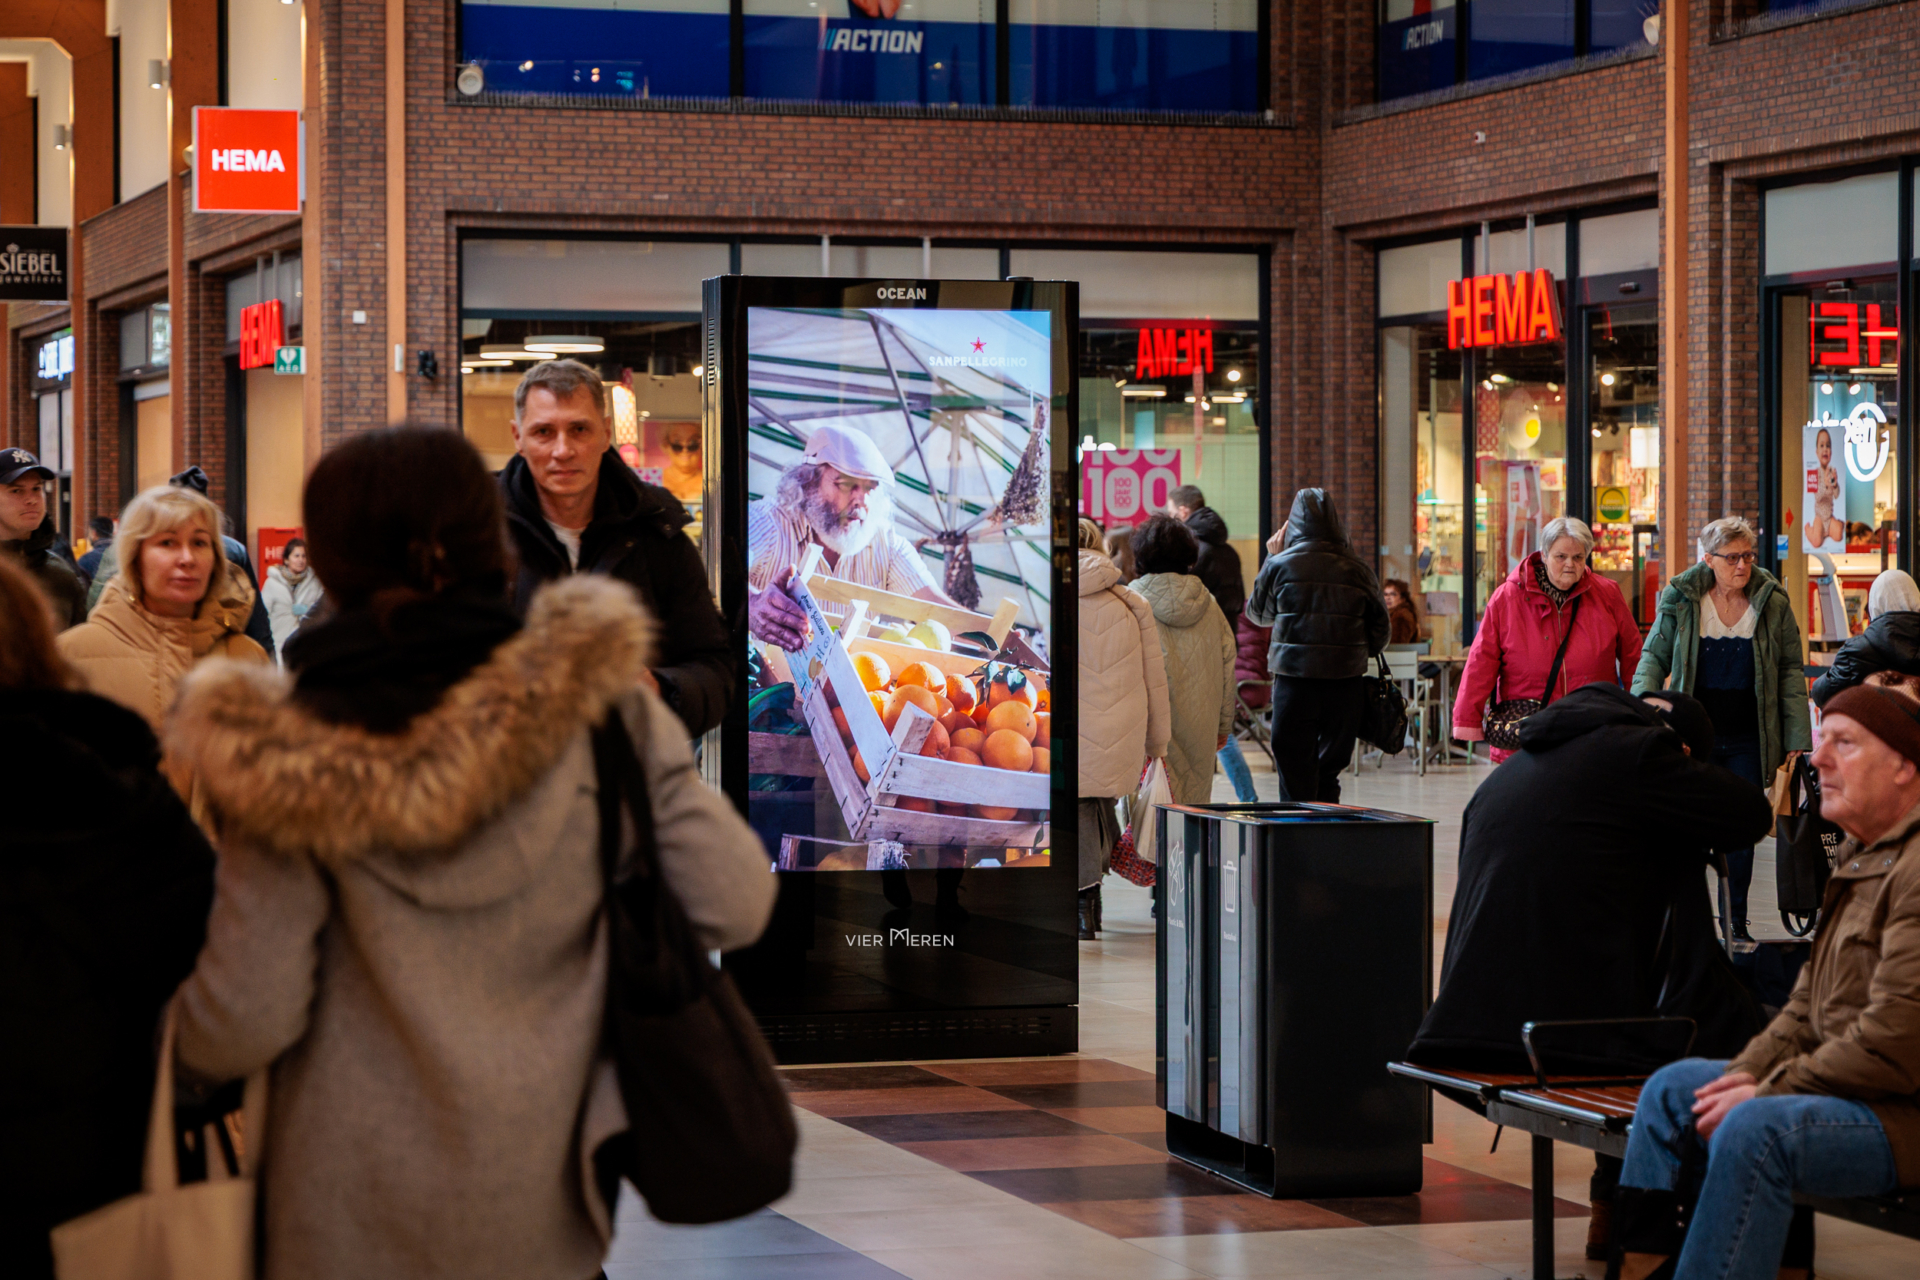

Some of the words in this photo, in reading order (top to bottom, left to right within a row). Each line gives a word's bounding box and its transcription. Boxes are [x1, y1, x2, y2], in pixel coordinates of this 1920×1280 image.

[831, 28, 924, 53] ACTION
[1406, 20, 1444, 50] ACTION
[212, 149, 285, 172] HEMA
[0, 252, 62, 275] SIEBEL
[876, 287, 927, 300] OCEAN
[1447, 267, 1556, 349] HEMA
[240, 298, 282, 371] HEMA
[928, 356, 1028, 367] SANPELLEGRINO
[1087, 467, 1178, 518] 100
[265, 546, 285, 560] HE
[845, 934, 884, 947] VIER
[889, 928, 955, 947] MEREN
